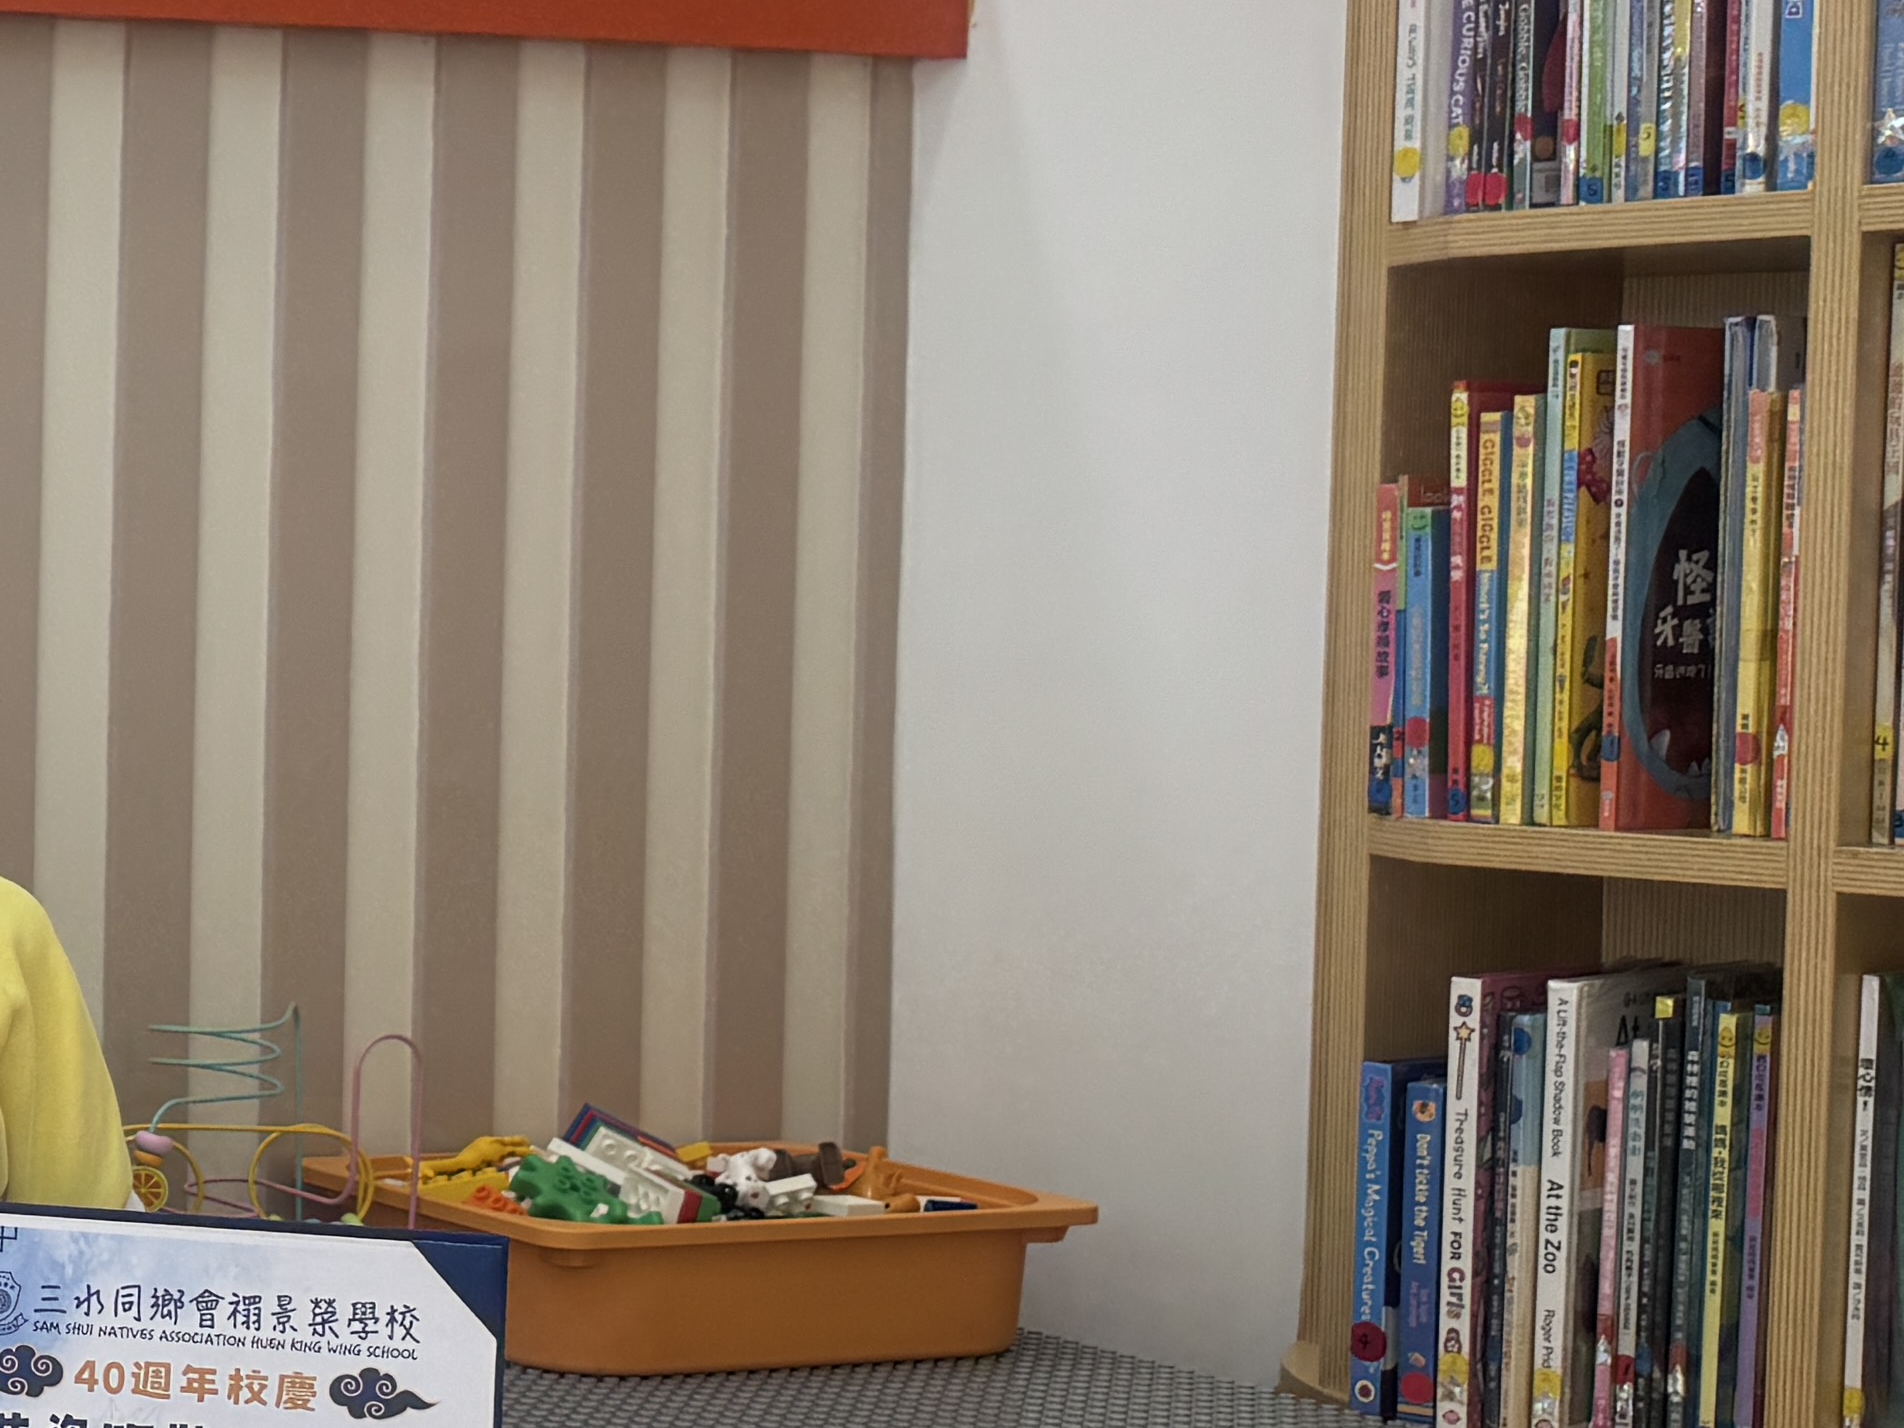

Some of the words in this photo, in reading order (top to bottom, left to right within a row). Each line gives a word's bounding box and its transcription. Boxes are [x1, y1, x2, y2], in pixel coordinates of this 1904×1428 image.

[1452, 13, 1476, 92] CURIOUS
[1451, 1108, 1469, 1181] Treasure
[1450, 1186, 1468, 1225] Hunt
[1546, 1179, 1565, 1200] At
[1361, 1183, 1382, 1242] Magical
[1544, 1204, 1564, 1234] the
[1449, 1230, 1463, 1262] FOR
[1543, 1238, 1563, 1275] Zoo
[1359, 1247, 1381, 1323] Creatures
[33, 1319, 61, 1335] SAM
[65, 1321, 95, 1337] SHUI
[98, 1324, 155, 1341] NATIVES
[158, 1329, 247, 1349] ASSOCIATION
[250, 1335, 287, 1352] HUEN
[290, 1338, 323, 1356] KING
[326, 1340, 363, 1358] WING
[366, 1344, 419, 1361] SCHOOL
[74, 1358, 319, 1413] 40週年校慶
